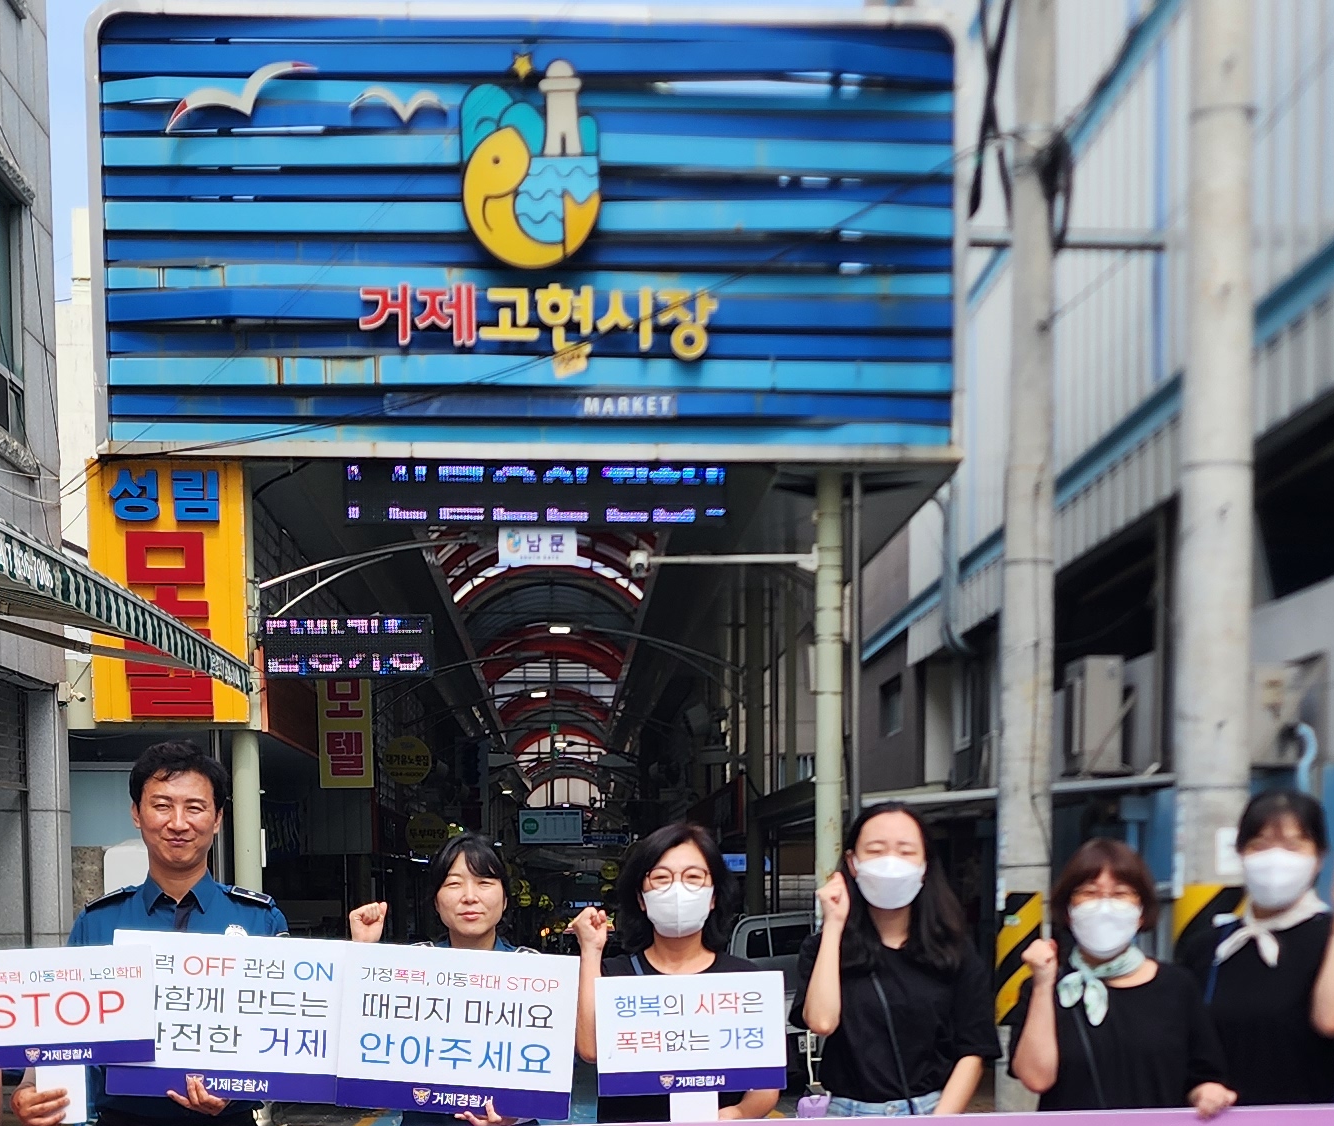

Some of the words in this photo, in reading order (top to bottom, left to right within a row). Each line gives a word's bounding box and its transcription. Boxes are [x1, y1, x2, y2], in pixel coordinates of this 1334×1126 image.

[358, 282, 719, 362] 거제고현시장
[583, 396, 672, 416] MARKET
[109, 469, 219, 522] 성림
[527, 533, 565, 552] 남문
[326, 678, 364, 777] 모텔
[29, 969, 86, 983] 아동학대,
[89, 966, 142, 981] 노인학대
[155, 953, 175, 975] 력
[183, 955, 237, 977] OFF
[242, 958, 285, 980] 관심
[294, 961, 334, 982] ON
[361, 966, 430, 986] 가정폭력,
[436, 971, 501, 990] 아동학대
[506, 976, 560, 993] STOP
[238, 989, 328, 1018] 만드는
[361, 992, 451, 1024] 때리지
[464, 999, 553, 1029] 마세요
[614, 993, 684, 1018] 행복의
[694, 991, 764, 1016] 시작은
[259, 1027, 327, 1058] 거제
[360, 1032, 552, 1074] 안아주세요
[617, 1029, 710, 1053] 폭력없는
[719, 1026, 764, 1050] 가정
[41, 1048, 93, 1061] 거제경찰서
[205, 1077, 269, 1093] 거제경찰서
[675, 1074, 726, 1088] 거제경찰서
[431, 1091, 494, 1108] 거제경찰서
